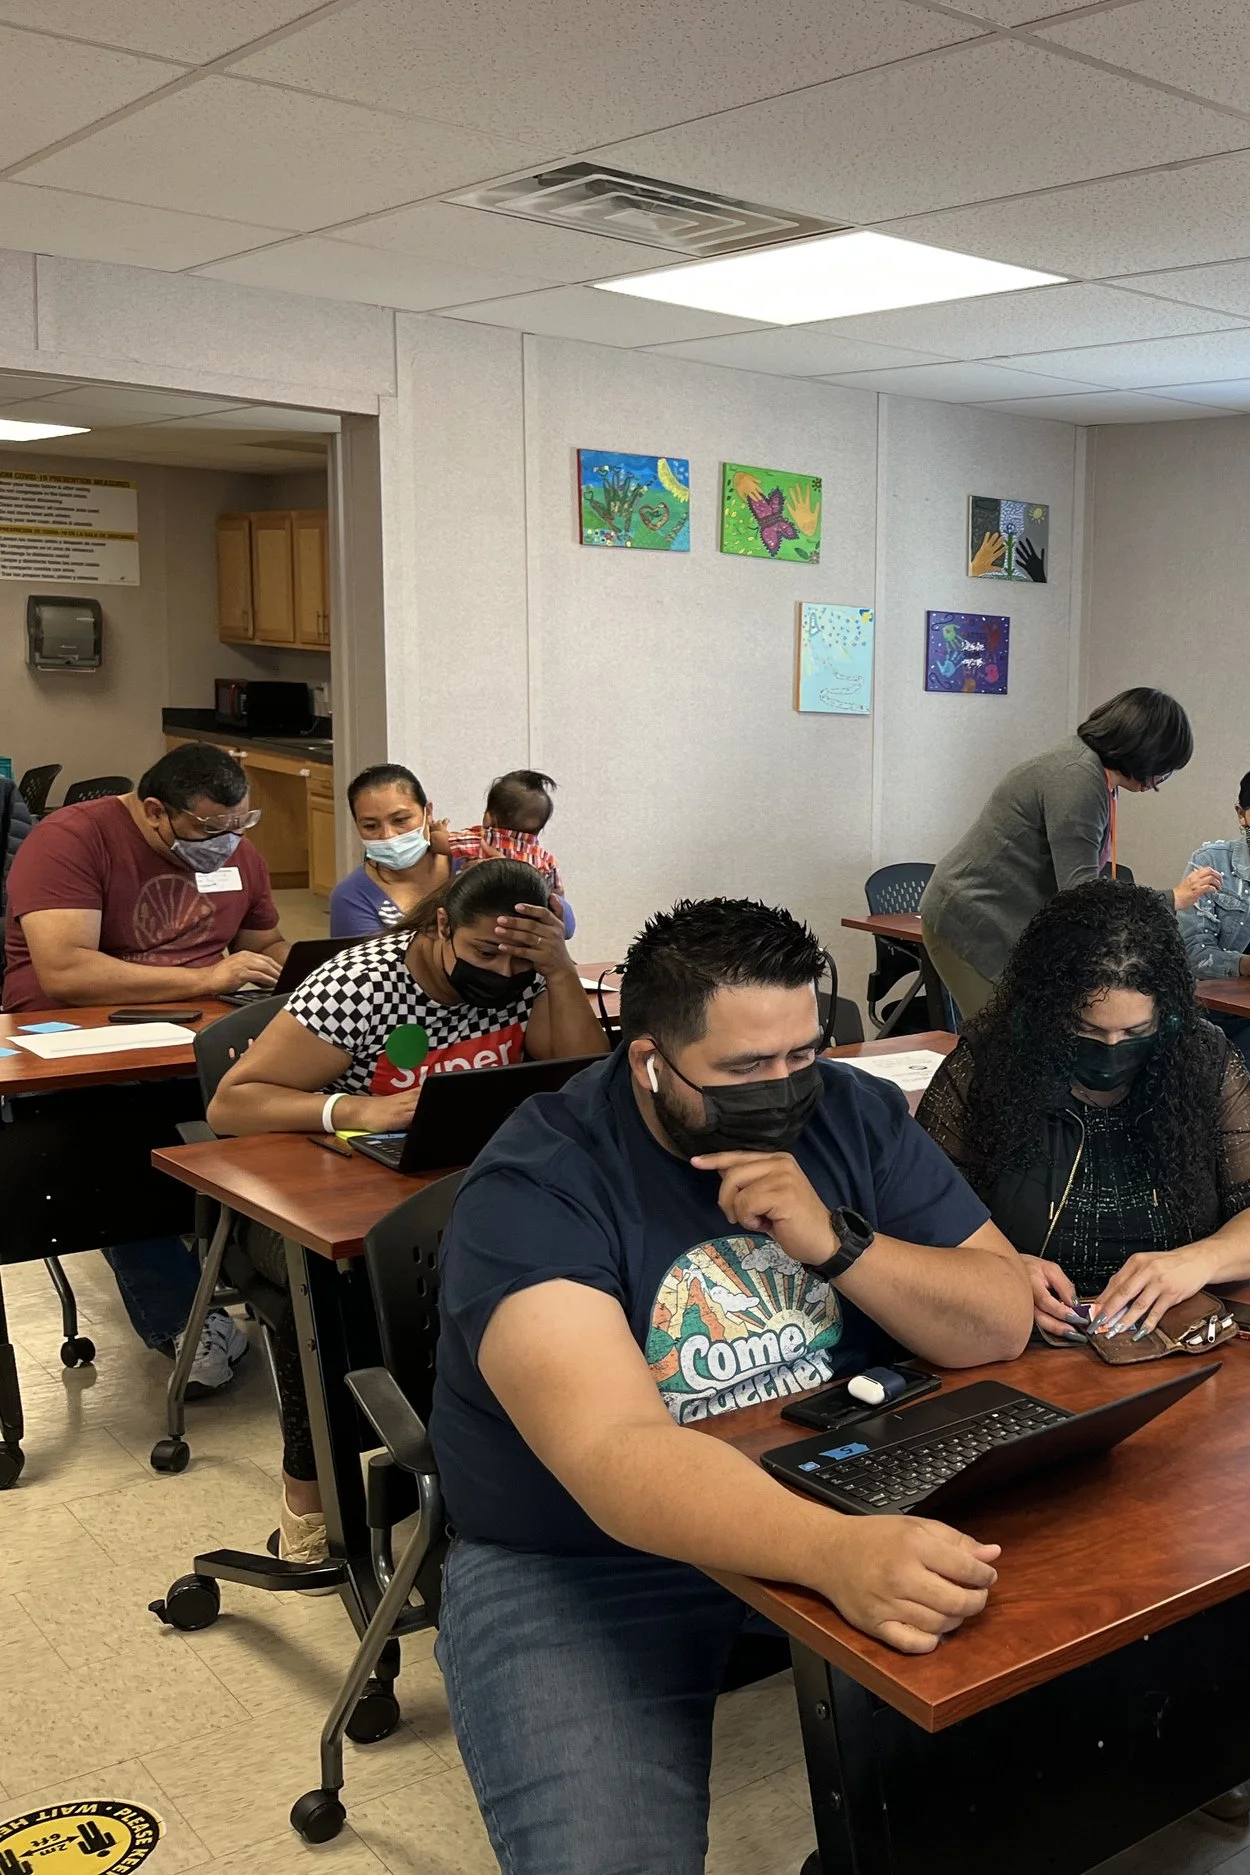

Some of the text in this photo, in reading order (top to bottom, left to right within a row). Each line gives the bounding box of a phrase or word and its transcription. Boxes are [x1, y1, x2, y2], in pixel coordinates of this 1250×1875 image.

[680, 1325, 807, 1391] Come
[36, 1803, 98, 1822] WAIT
[30, 1833, 61, 1847] 6ft
[106, 1807, 153, 1875] PLEASE KEE
[40, 1843, 68, 1857] 2m
